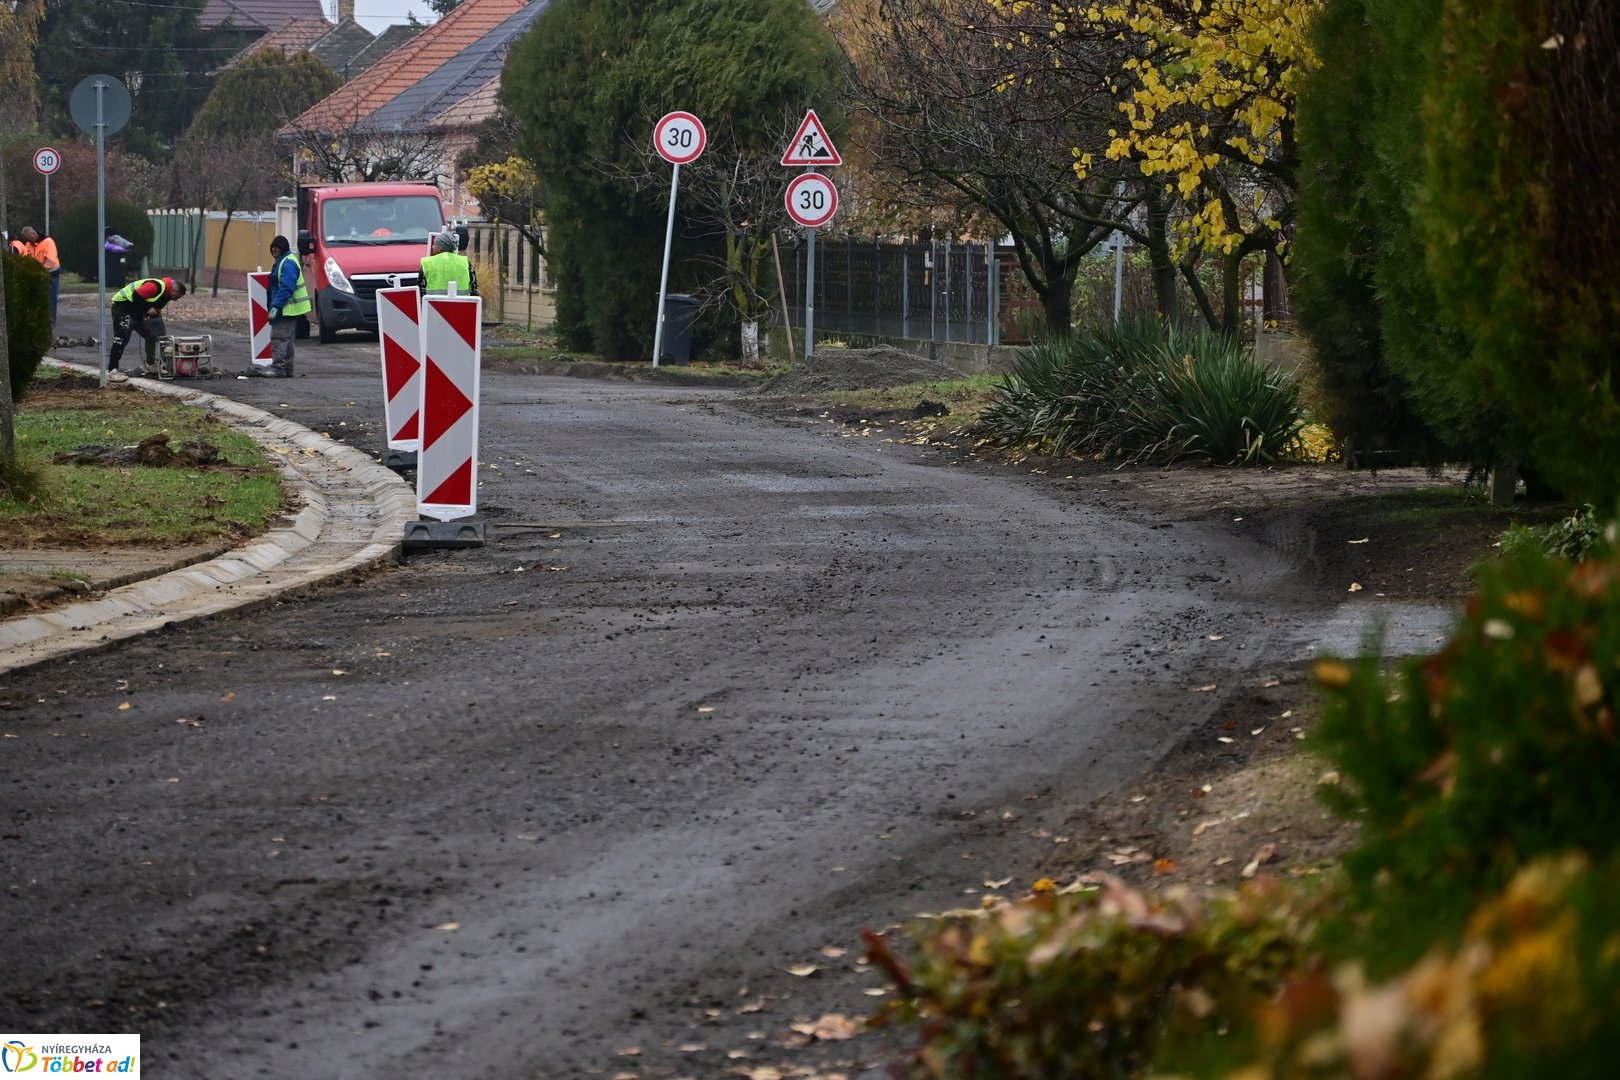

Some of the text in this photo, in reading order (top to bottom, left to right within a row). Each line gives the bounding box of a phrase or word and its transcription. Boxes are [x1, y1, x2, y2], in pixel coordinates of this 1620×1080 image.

[668, 128, 692, 148] 30
[40, 156, 53, 166] 30
[800, 190, 824, 209] 30
